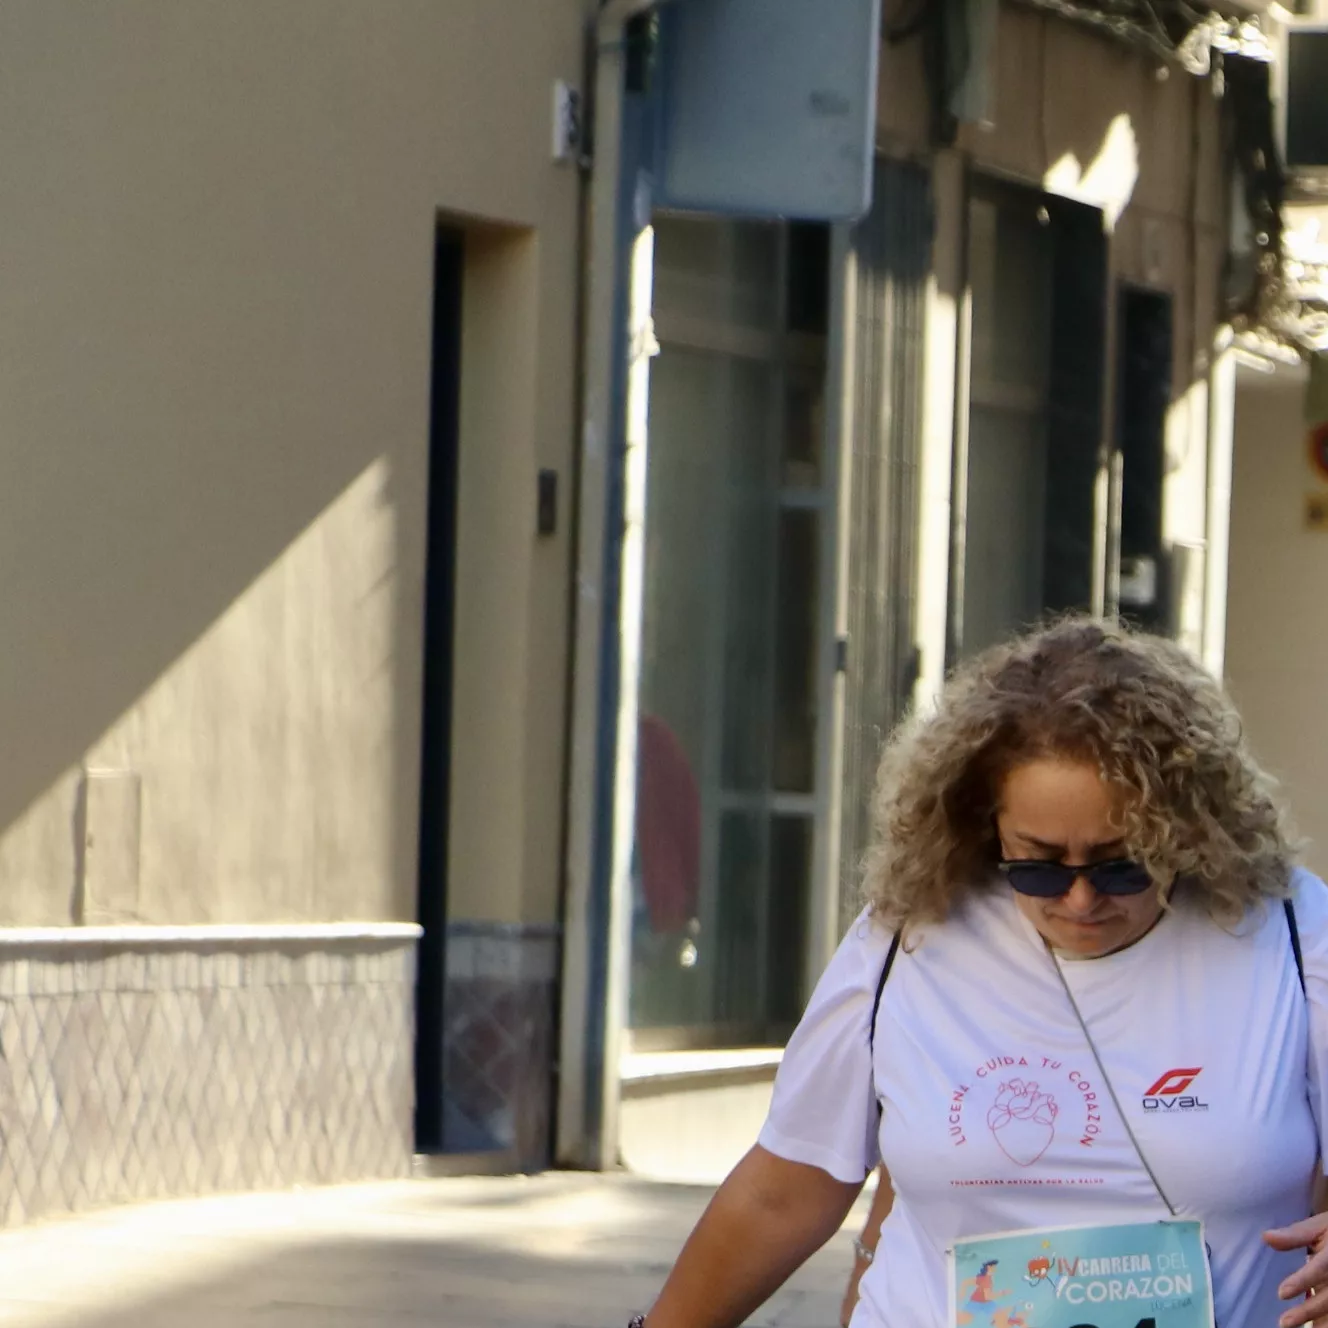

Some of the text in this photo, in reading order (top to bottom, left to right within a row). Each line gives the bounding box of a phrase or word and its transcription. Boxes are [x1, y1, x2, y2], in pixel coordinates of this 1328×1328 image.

[949, 1056, 1102, 1148] LUCENA CUIDA TU CORAZÓN
[1057, 1252, 1189, 1277] IV CARRERA DEL
[1065, 1271, 1193, 1305] CORAZÓN
